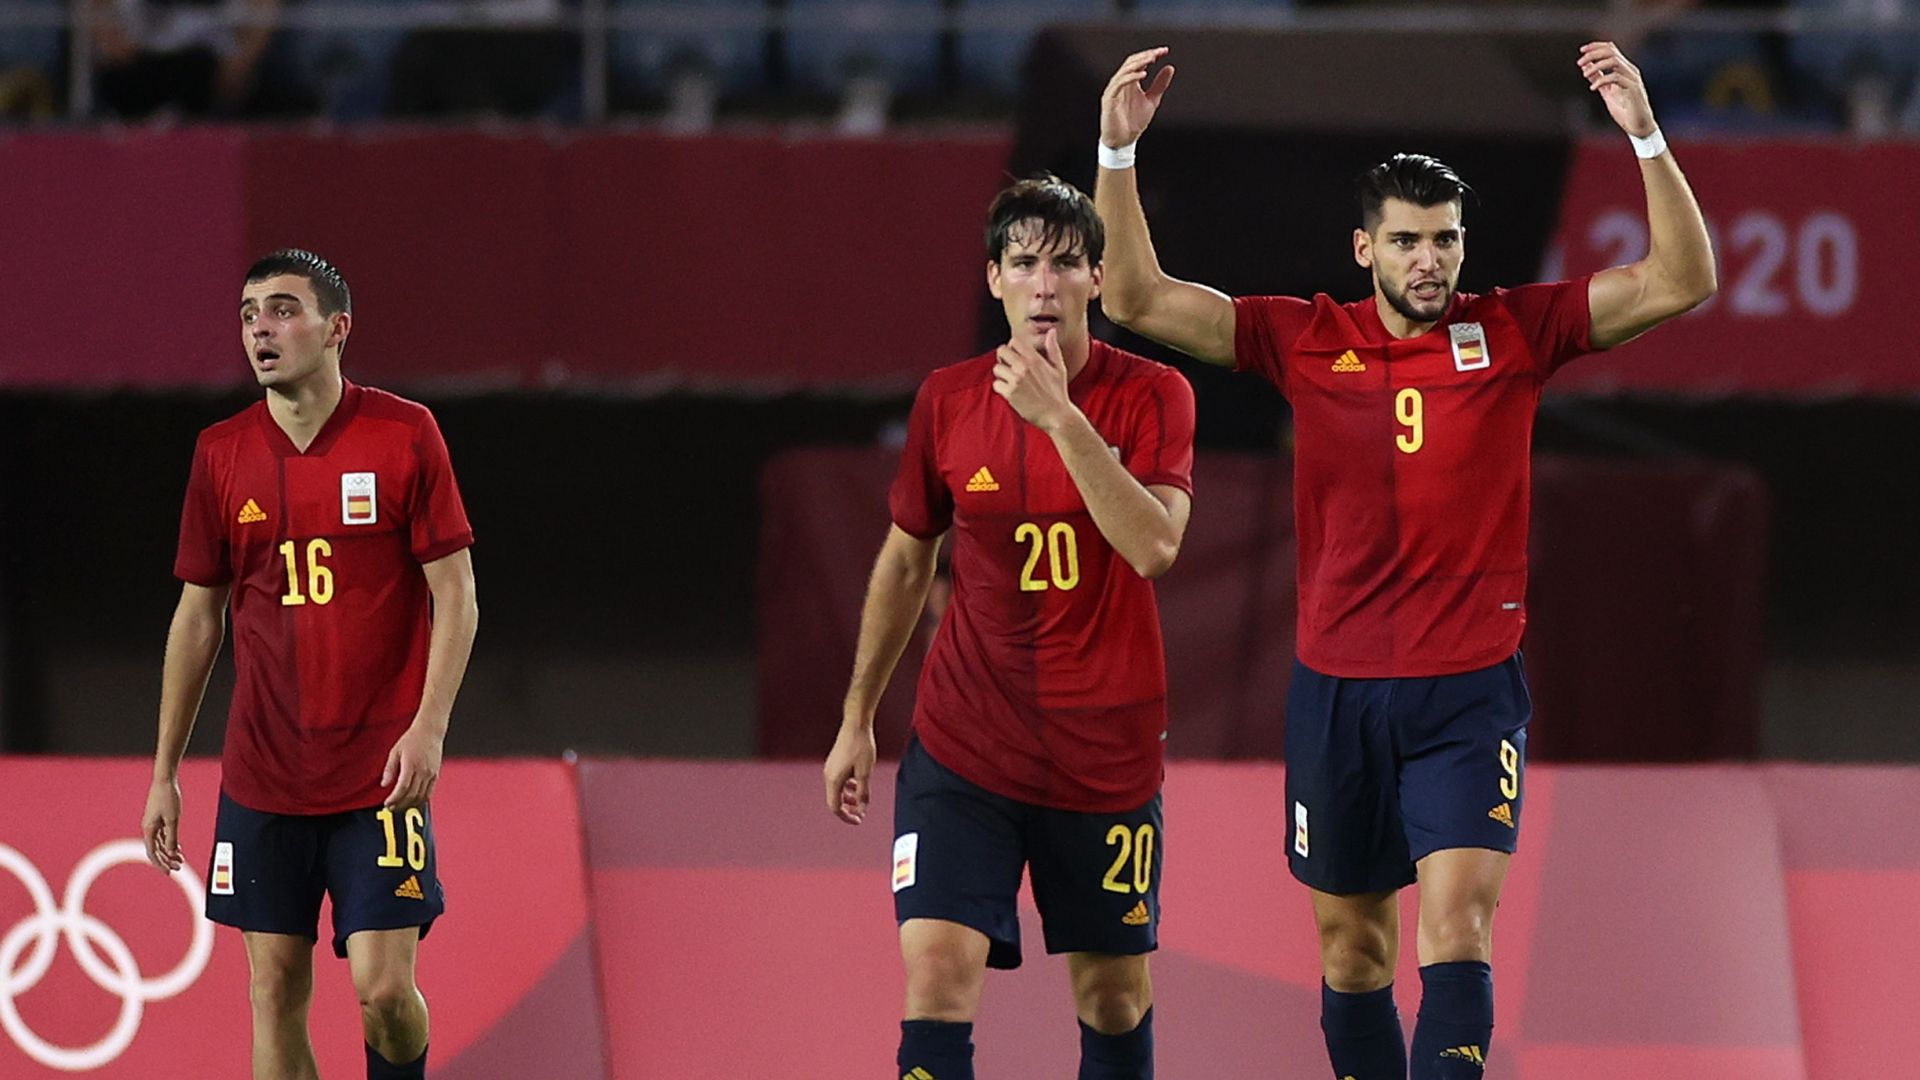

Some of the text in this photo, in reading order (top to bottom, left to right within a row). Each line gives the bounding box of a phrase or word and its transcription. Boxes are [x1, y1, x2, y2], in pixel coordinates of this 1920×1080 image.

[1590, 211, 1859, 318] 220
[1331, 362, 1366, 373] adidas
[1395, 387, 1424, 454] 9
[279, 538, 334, 605] 16
[1014, 522, 1080, 591] 20
[1500, 739, 1518, 800] 9
[376, 807, 427, 871] 16
[1102, 823, 1154, 894] 20
